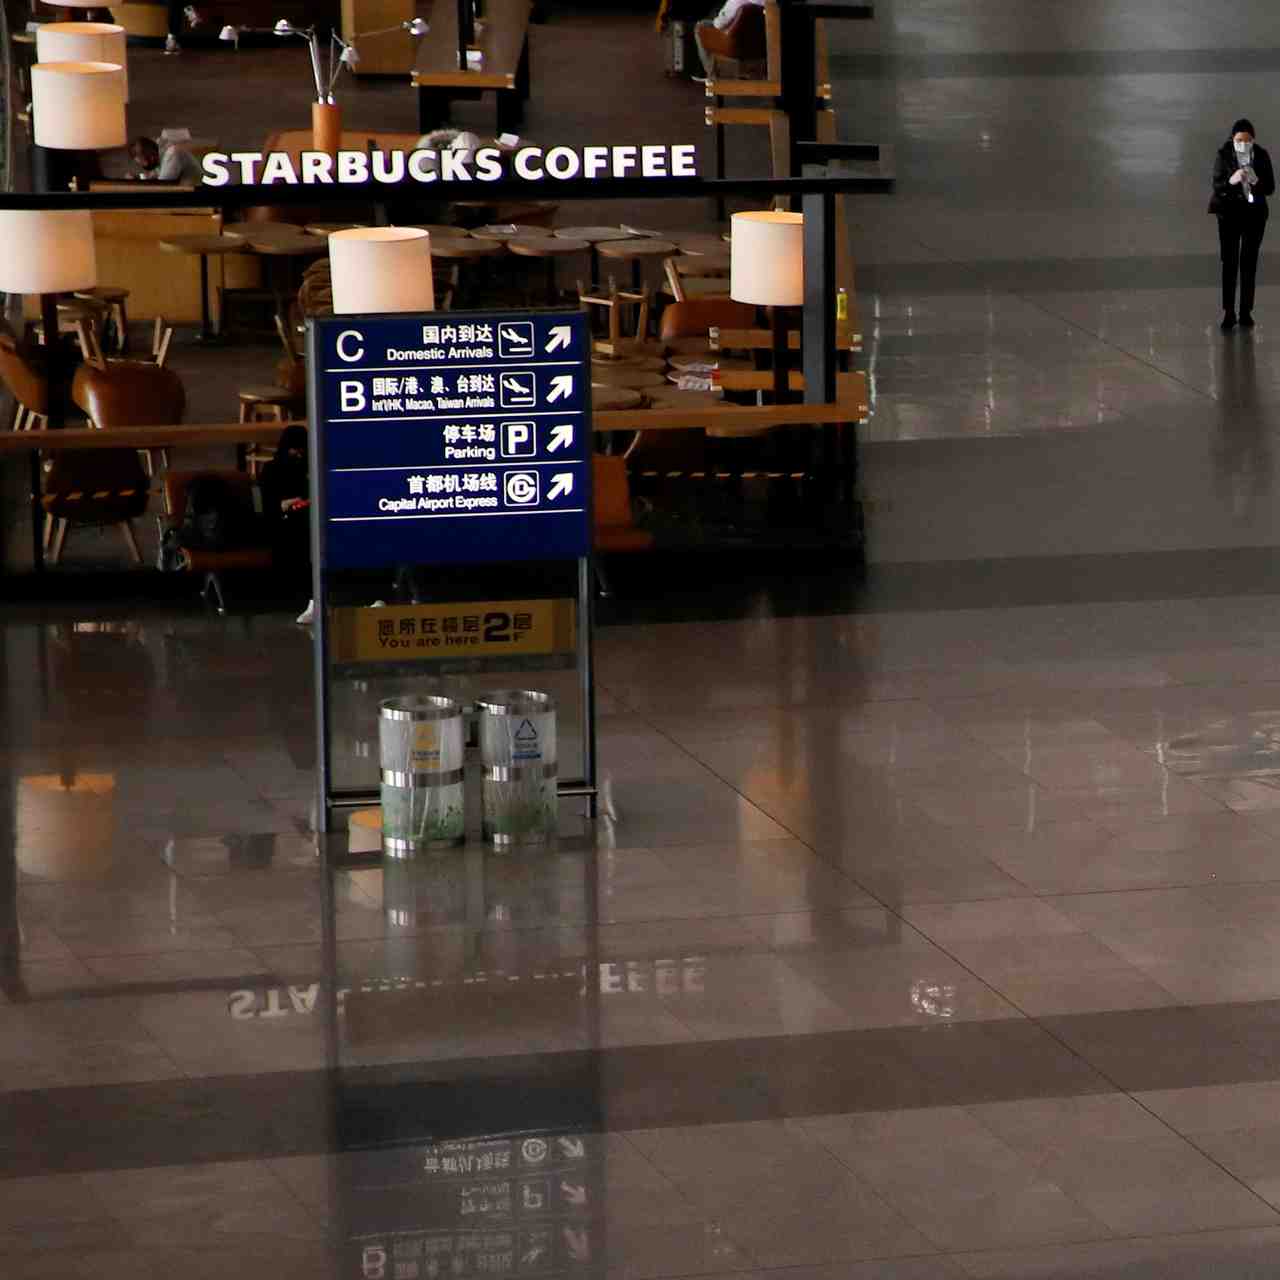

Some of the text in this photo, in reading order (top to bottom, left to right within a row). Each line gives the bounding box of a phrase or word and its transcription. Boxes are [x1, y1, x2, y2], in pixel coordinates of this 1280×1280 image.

[201, 145, 696, 187] STARBUCKS COFFEE
[423, 324, 493, 344] 国内到达
[337, 330, 364, 362] C
[387, 346, 493, 360] Domestic Arrivals
[341, 381, 365, 411] B
[465, 396, 495, 408] Arrivals
[443, 424, 495, 443] 停车场
[445, 446, 495, 460] Parking
[407, 472, 497, 494] 首都机场线
[379, 496, 498, 512] Capital Airport Express
